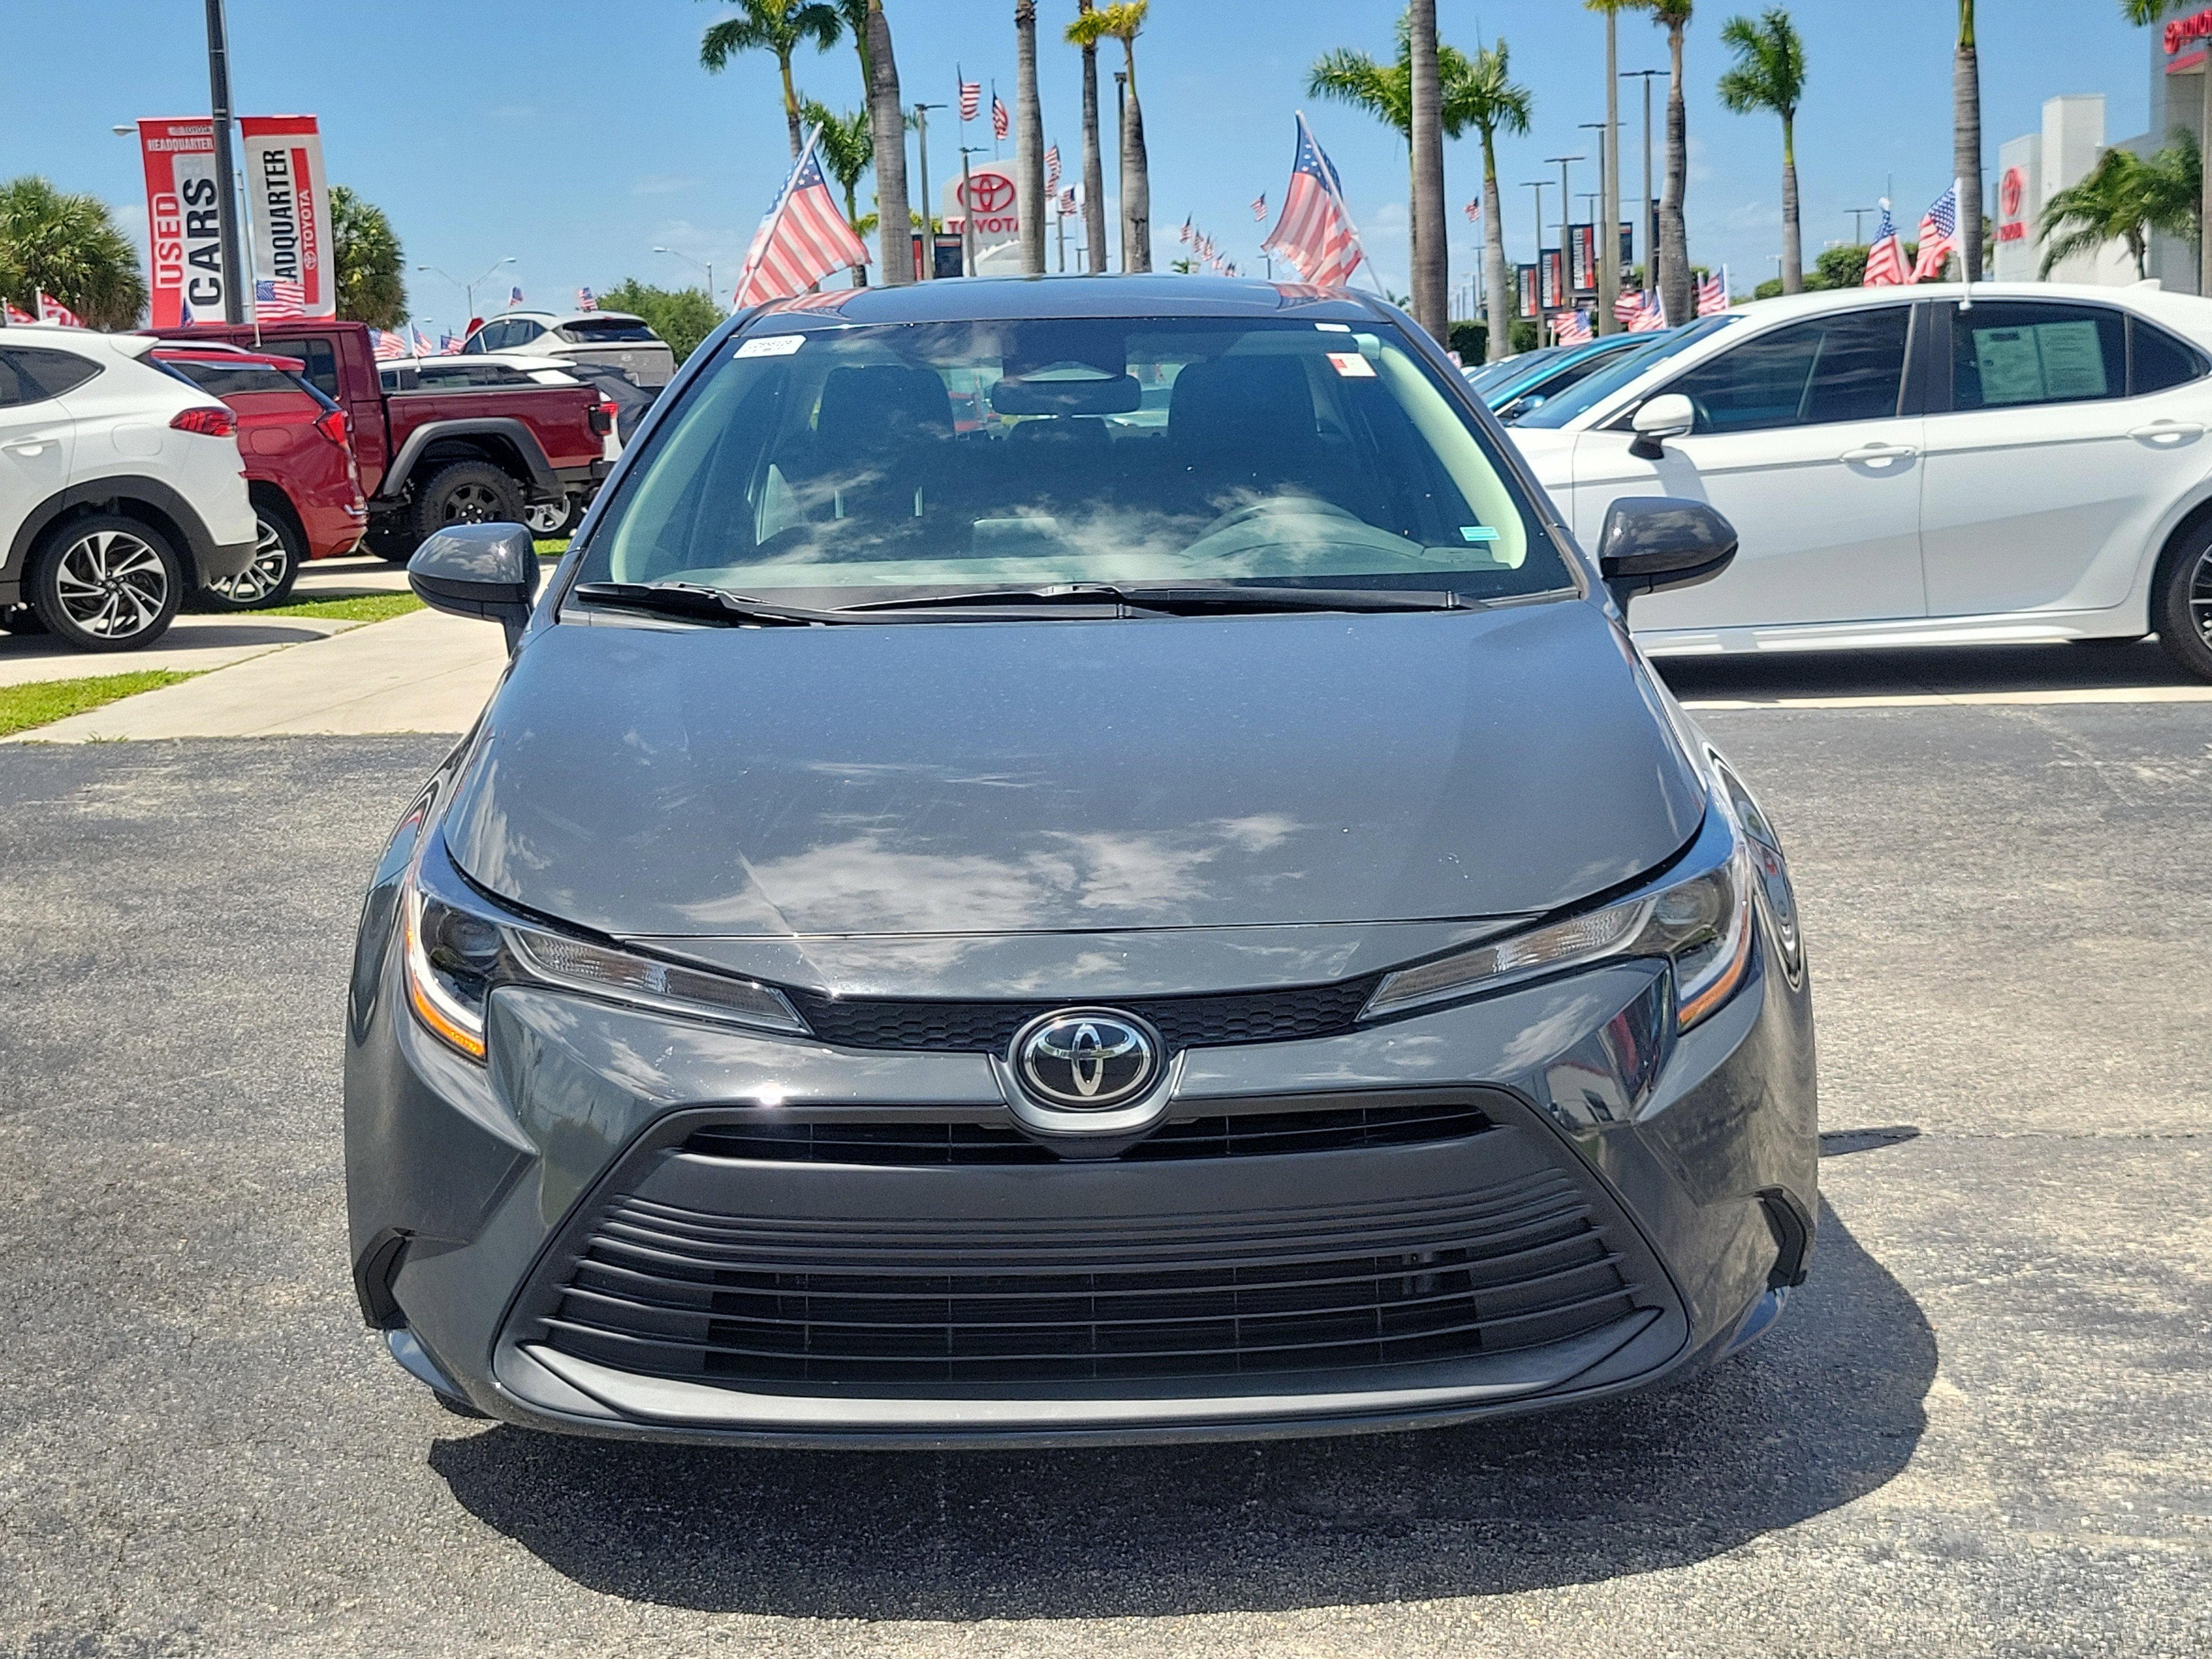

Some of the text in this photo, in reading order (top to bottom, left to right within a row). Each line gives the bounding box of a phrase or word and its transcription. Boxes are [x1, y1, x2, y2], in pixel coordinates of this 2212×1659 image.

[155, 196, 184, 285] USED
[183, 178, 222, 306] CARS
[263, 150, 299, 284] ADQUARTER
[299, 189, 315, 250] TOYOTA
